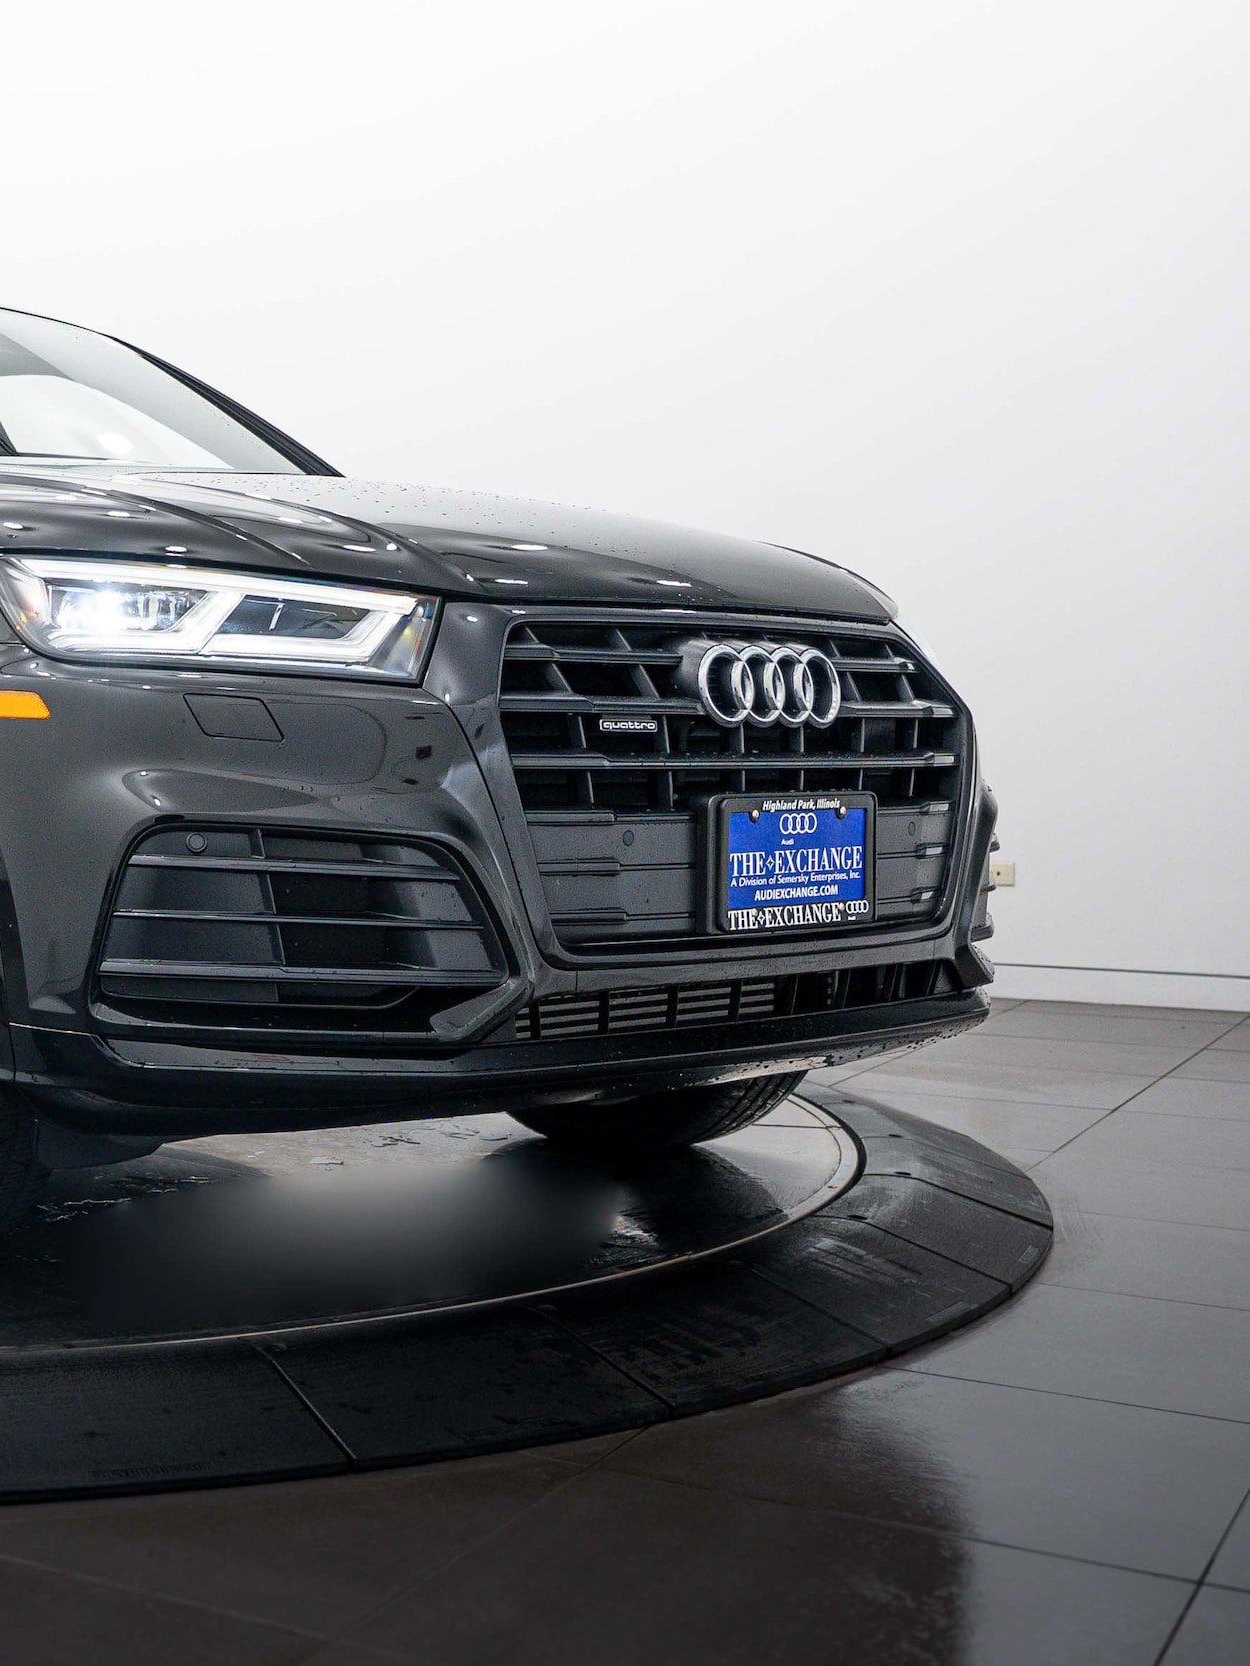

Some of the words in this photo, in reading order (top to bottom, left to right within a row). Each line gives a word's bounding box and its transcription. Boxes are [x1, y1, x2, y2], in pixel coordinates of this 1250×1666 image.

[603, 721, 656, 730] quattro
[762, 800, 797, 813] Highland
[798, 799, 816, 811] Park,
[817, 798, 841, 809] Illinois
[730, 851, 766, 877] THE
[774, 846, 862, 873] EXCHANGE
[739, 877, 767, 887] Division
[768, 875, 777, 885] of
[810, 870, 849, 882] Enterprises,
[849, 870, 861, 879] Inc.
[754, 885, 839, 901] AUDIEXCHANGE.COM
[728, 908, 759, 930] THE
[764, 902, 841, 928] EXCHANGE
